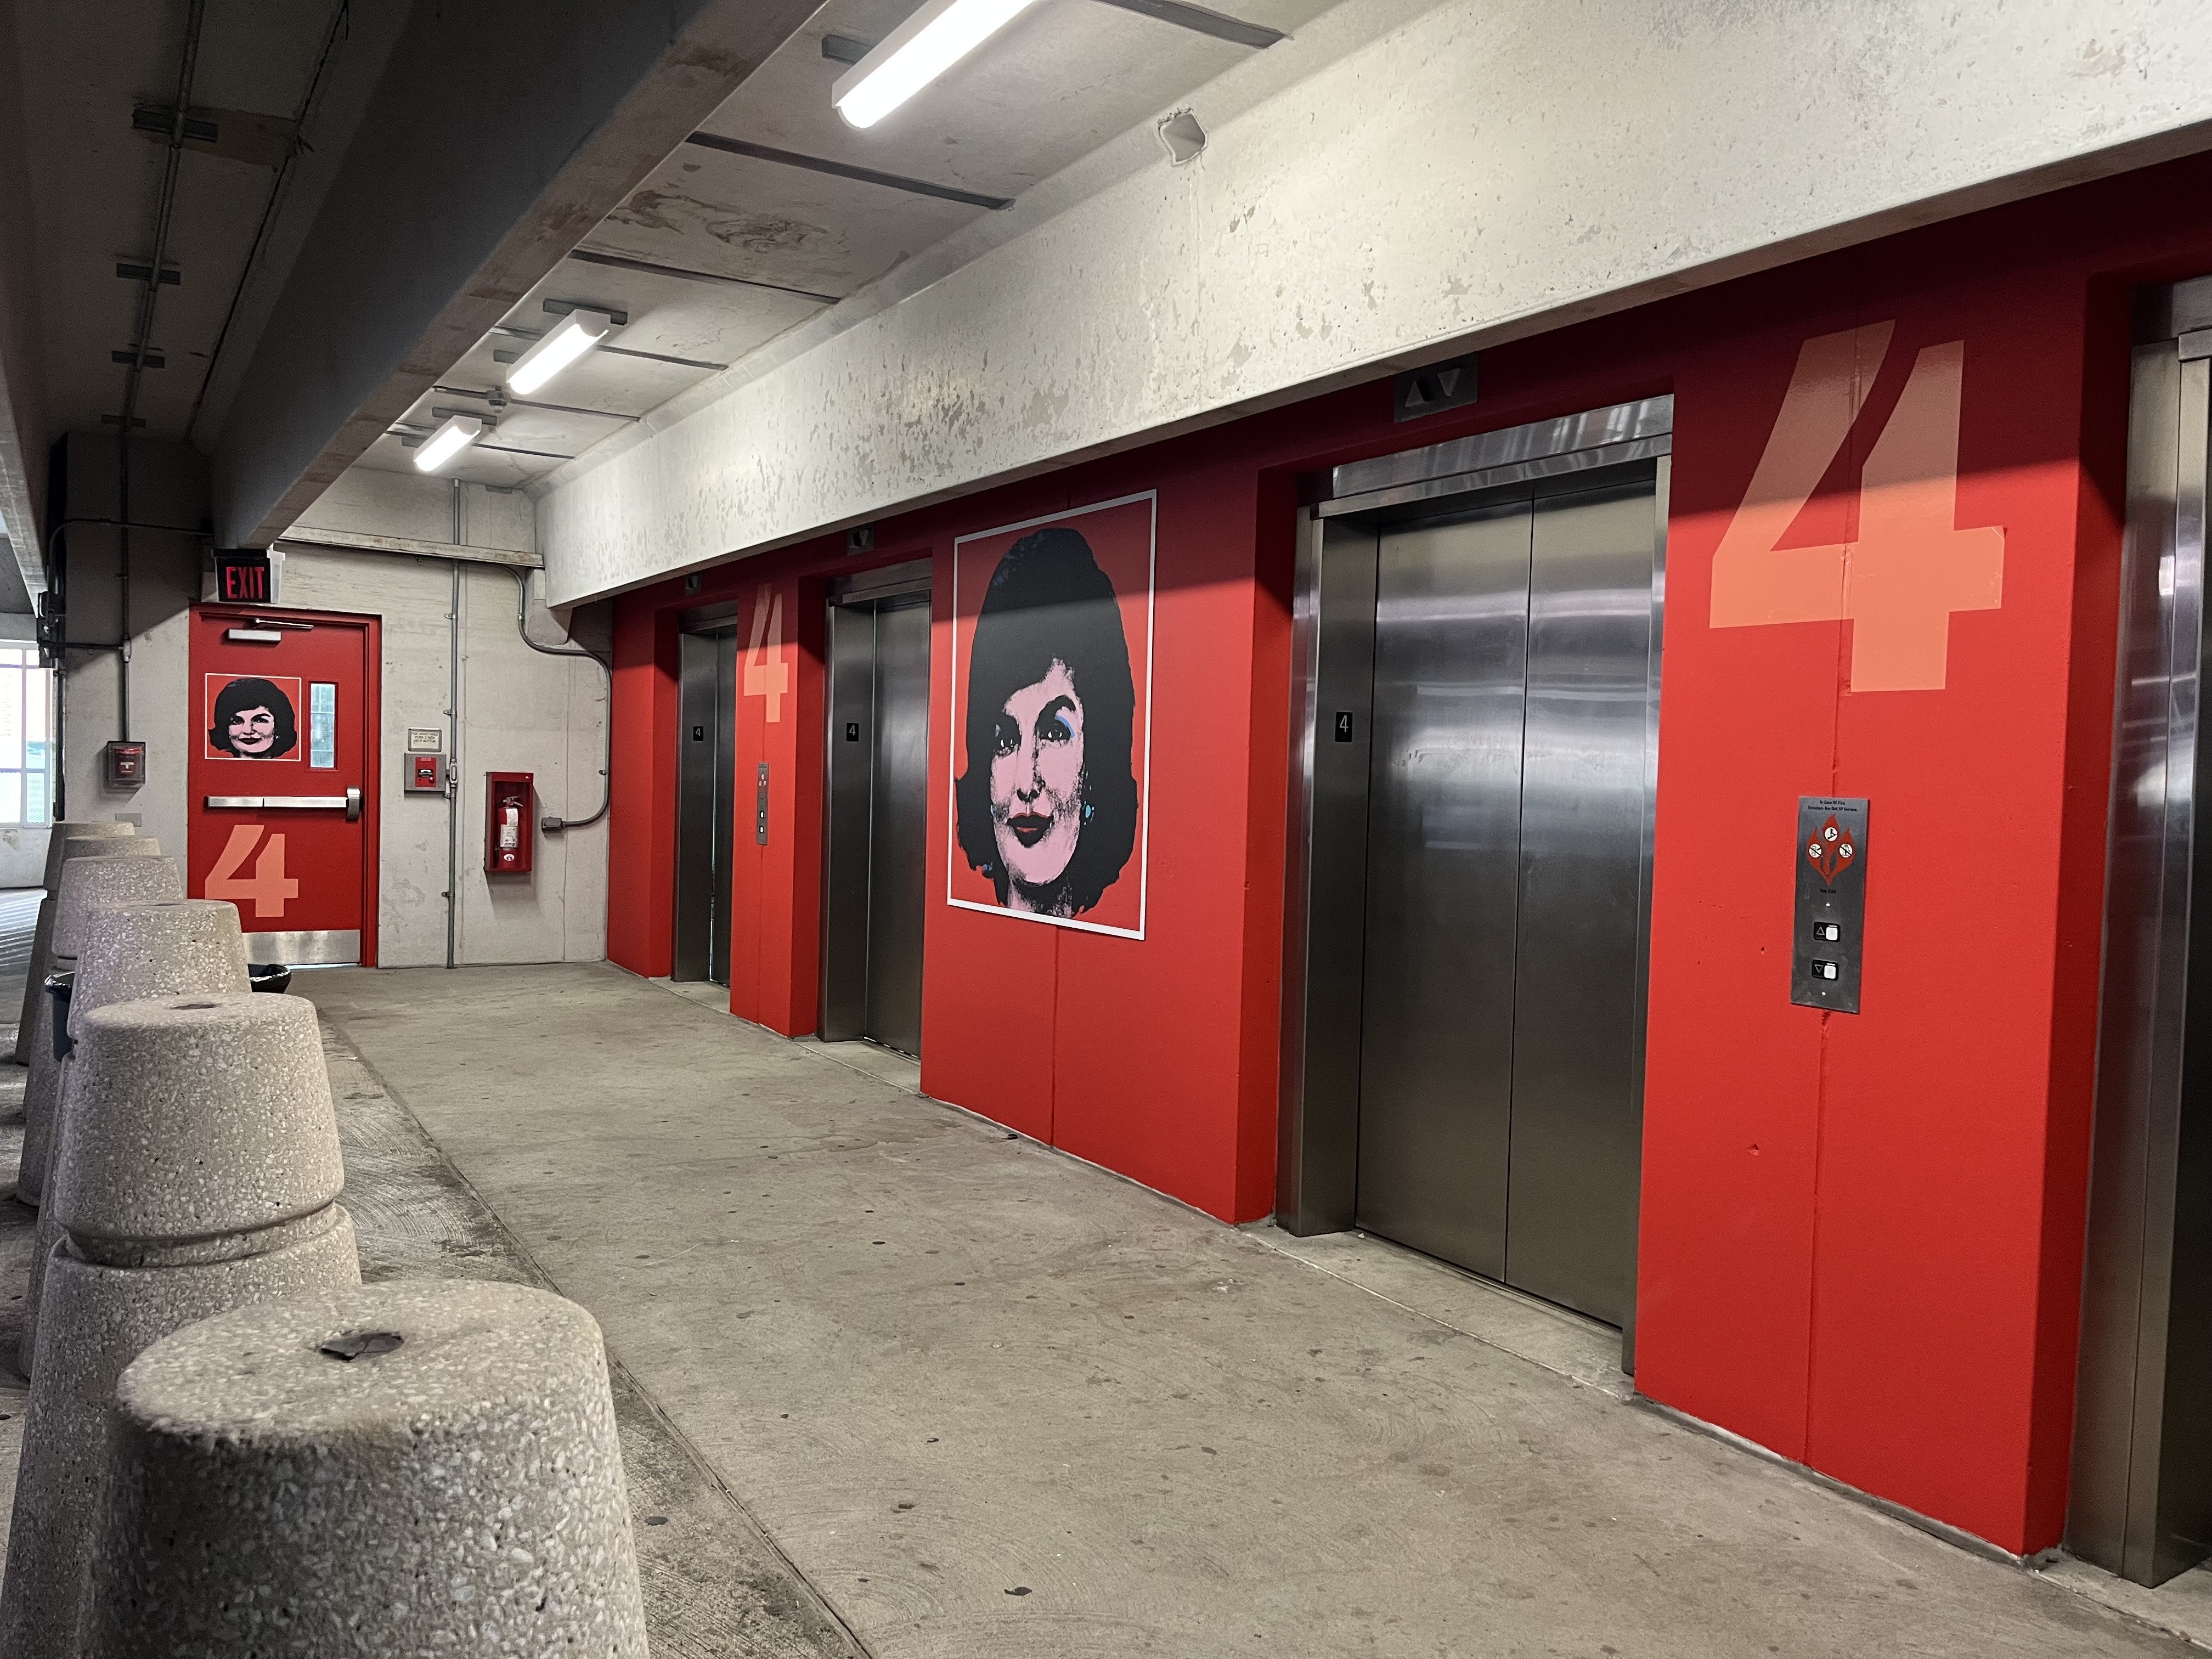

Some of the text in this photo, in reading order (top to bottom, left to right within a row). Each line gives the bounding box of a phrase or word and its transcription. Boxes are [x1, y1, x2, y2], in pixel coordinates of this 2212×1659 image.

[1709, 319, 2005, 692] 4
[227, 567, 264, 599] EXIT
[744, 583, 788, 723] 4
[695, 727, 701, 737] 4
[849, 725, 856, 736] 4
[1339, 715, 1349, 732] 4
[205, 825, 298, 917] 4
